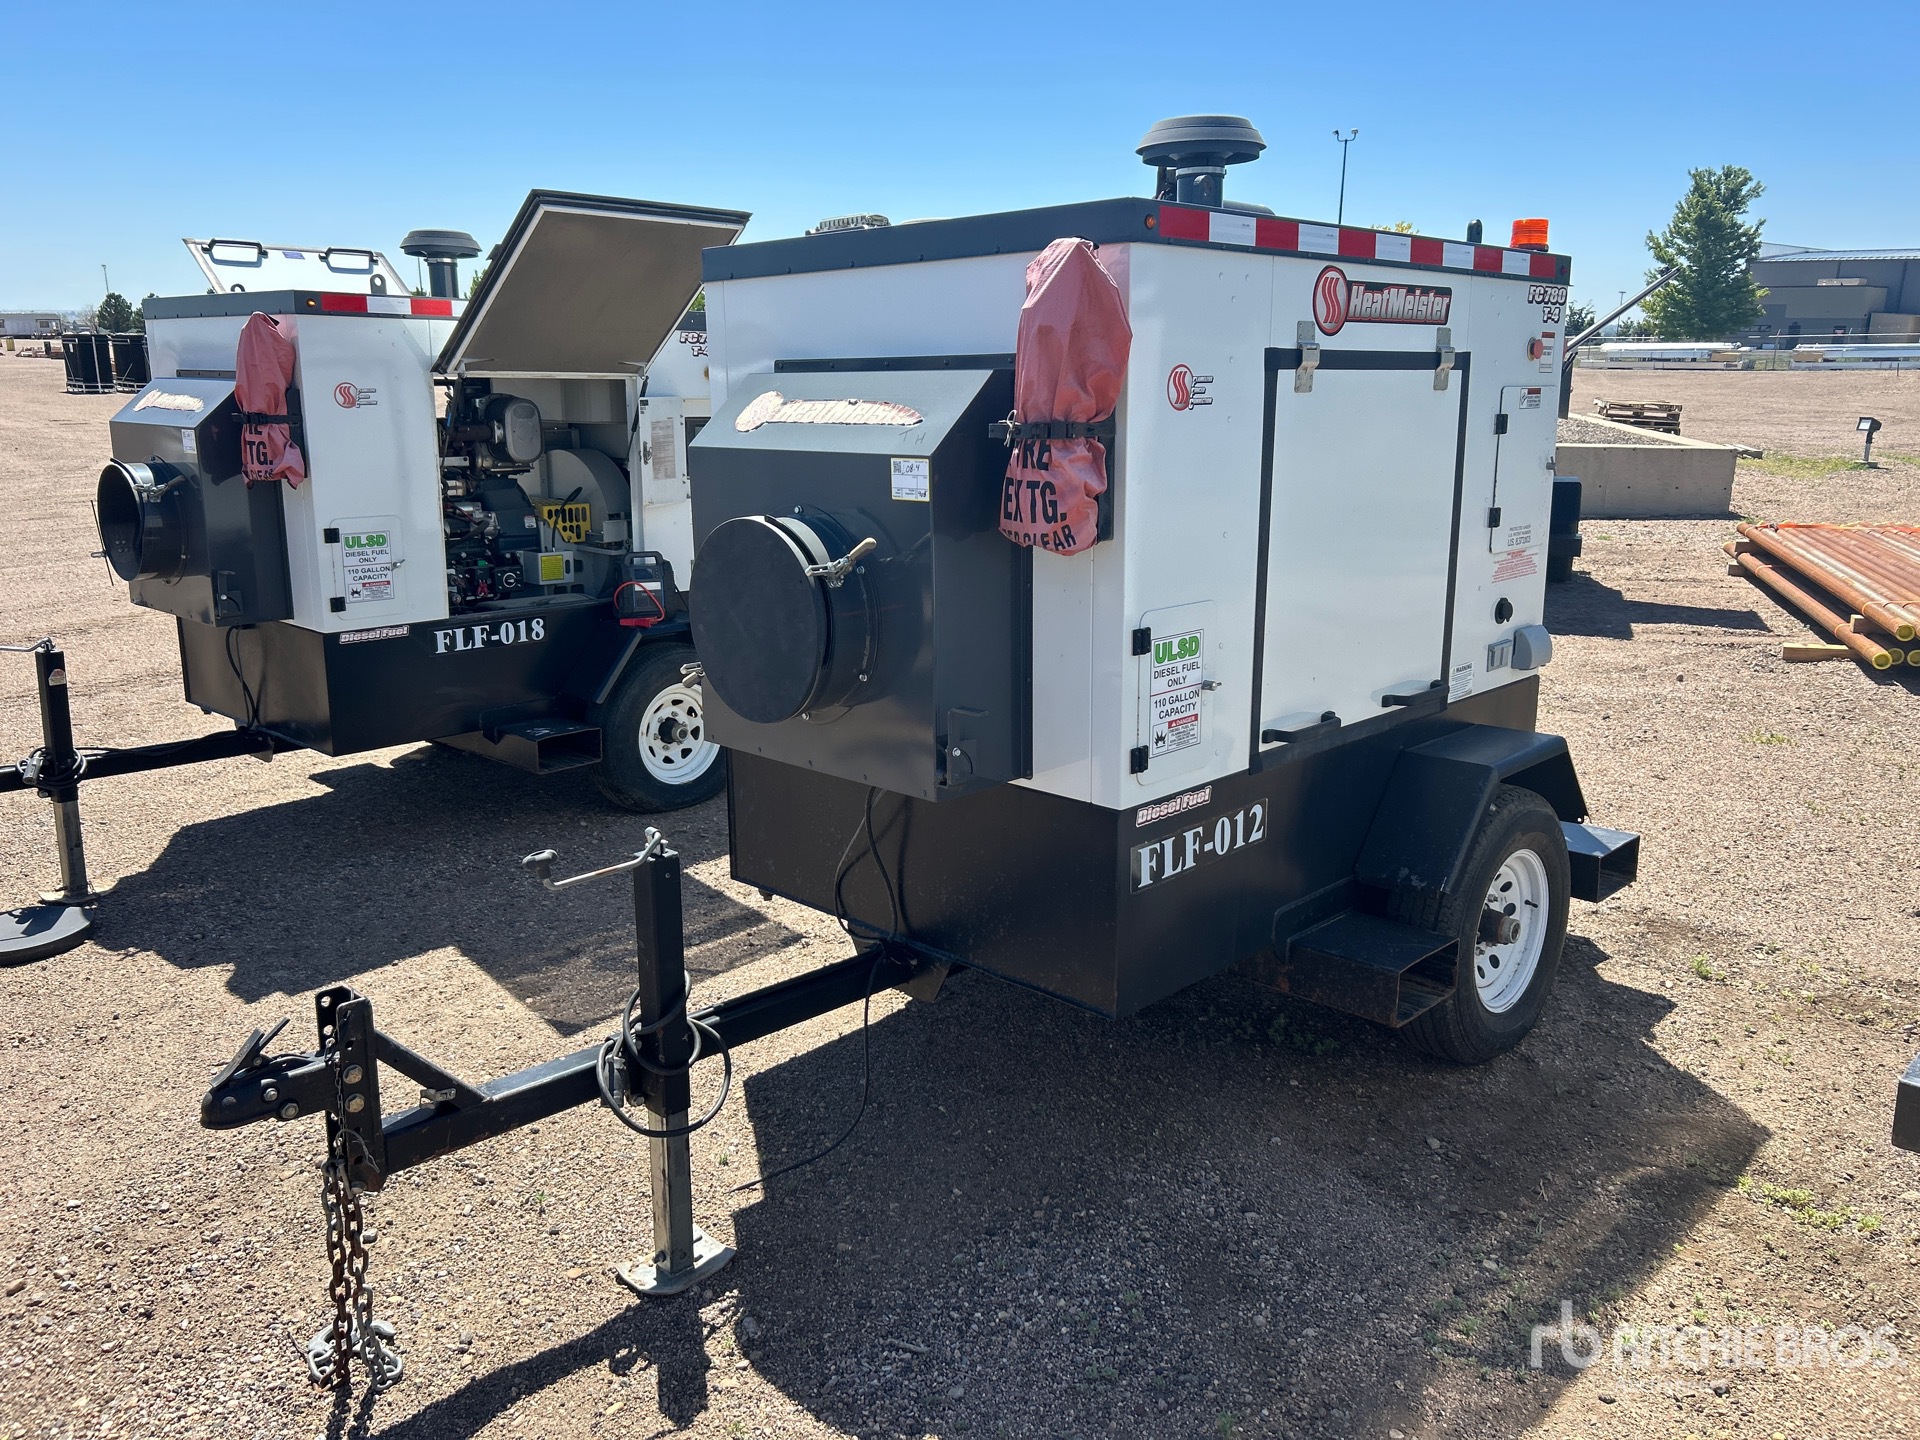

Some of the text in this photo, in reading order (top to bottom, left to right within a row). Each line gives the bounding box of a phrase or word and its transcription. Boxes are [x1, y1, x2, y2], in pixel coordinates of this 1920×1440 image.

[1347, 283, 1450, 323] HeatMeister
[1528, 285, 1567, 306] FC780
[1542, 306, 1560, 323] T-4
[679, 332, 708, 344] FC7
[344, 533, 387, 549] ULSD
[352, 573, 388, 582] CAPACITY
[360, 565, 391, 574] GALLON
[434, 618, 546, 654] FLF-018
[1154, 635, 1200, 665] ULSD
[1153, 661, 1201, 680] DIESEL FUEL
[1167, 674, 1187, 688] ONLY
[1153, 689, 1200, 709] 110 GALLON
[1158, 701, 1197, 720] CAPACITY
[1136, 785, 1212, 827] Diesel Fuel
[1137, 803, 1265, 888] FLF-012
